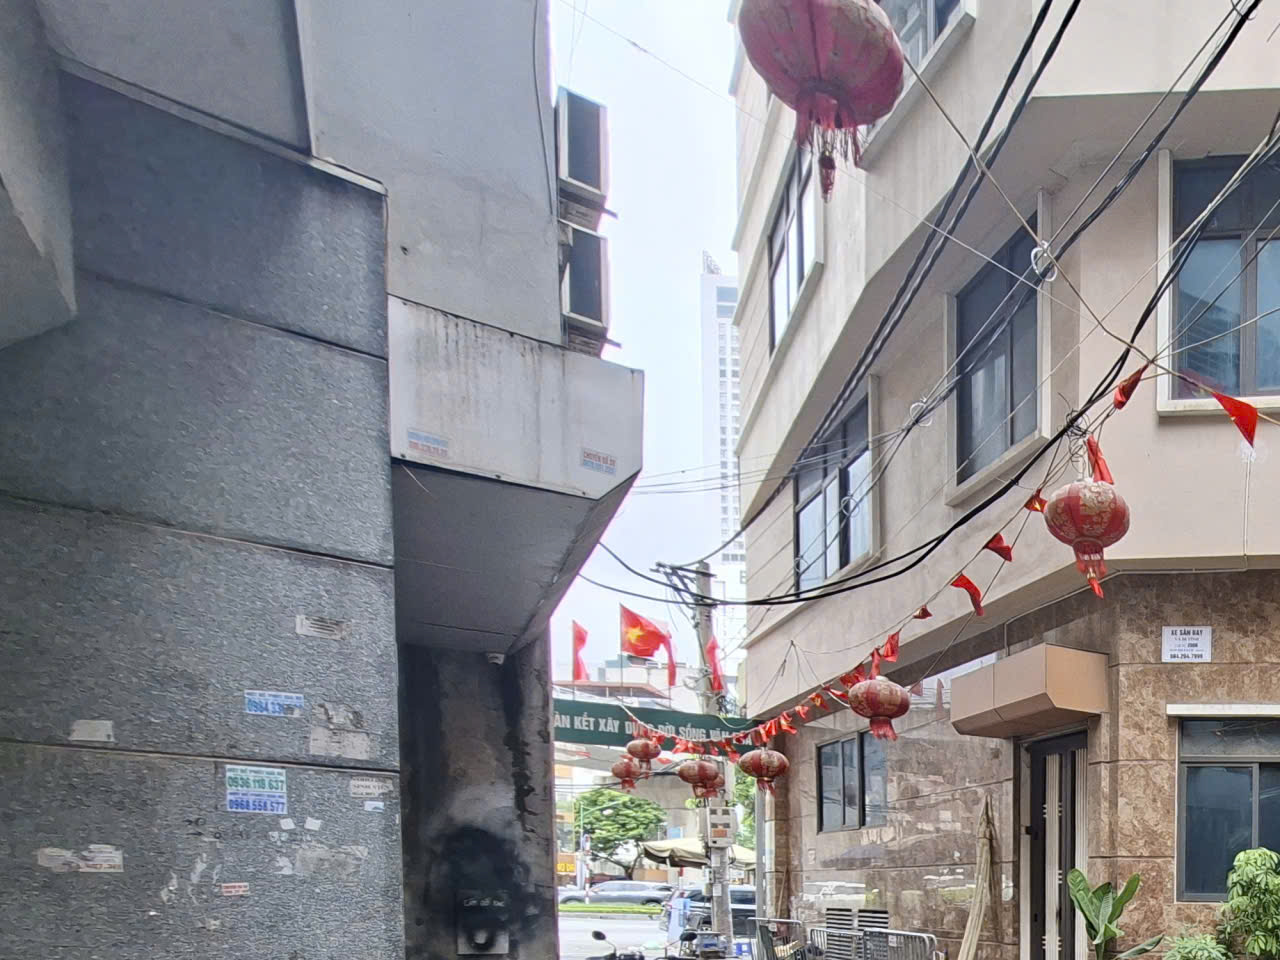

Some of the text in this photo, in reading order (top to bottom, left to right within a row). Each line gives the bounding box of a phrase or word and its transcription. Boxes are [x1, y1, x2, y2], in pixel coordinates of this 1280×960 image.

[573, 711, 595, 731] KẾT
[598, 716, 620, 734] XÂY
[678, 722, 706, 741] SỐNG
